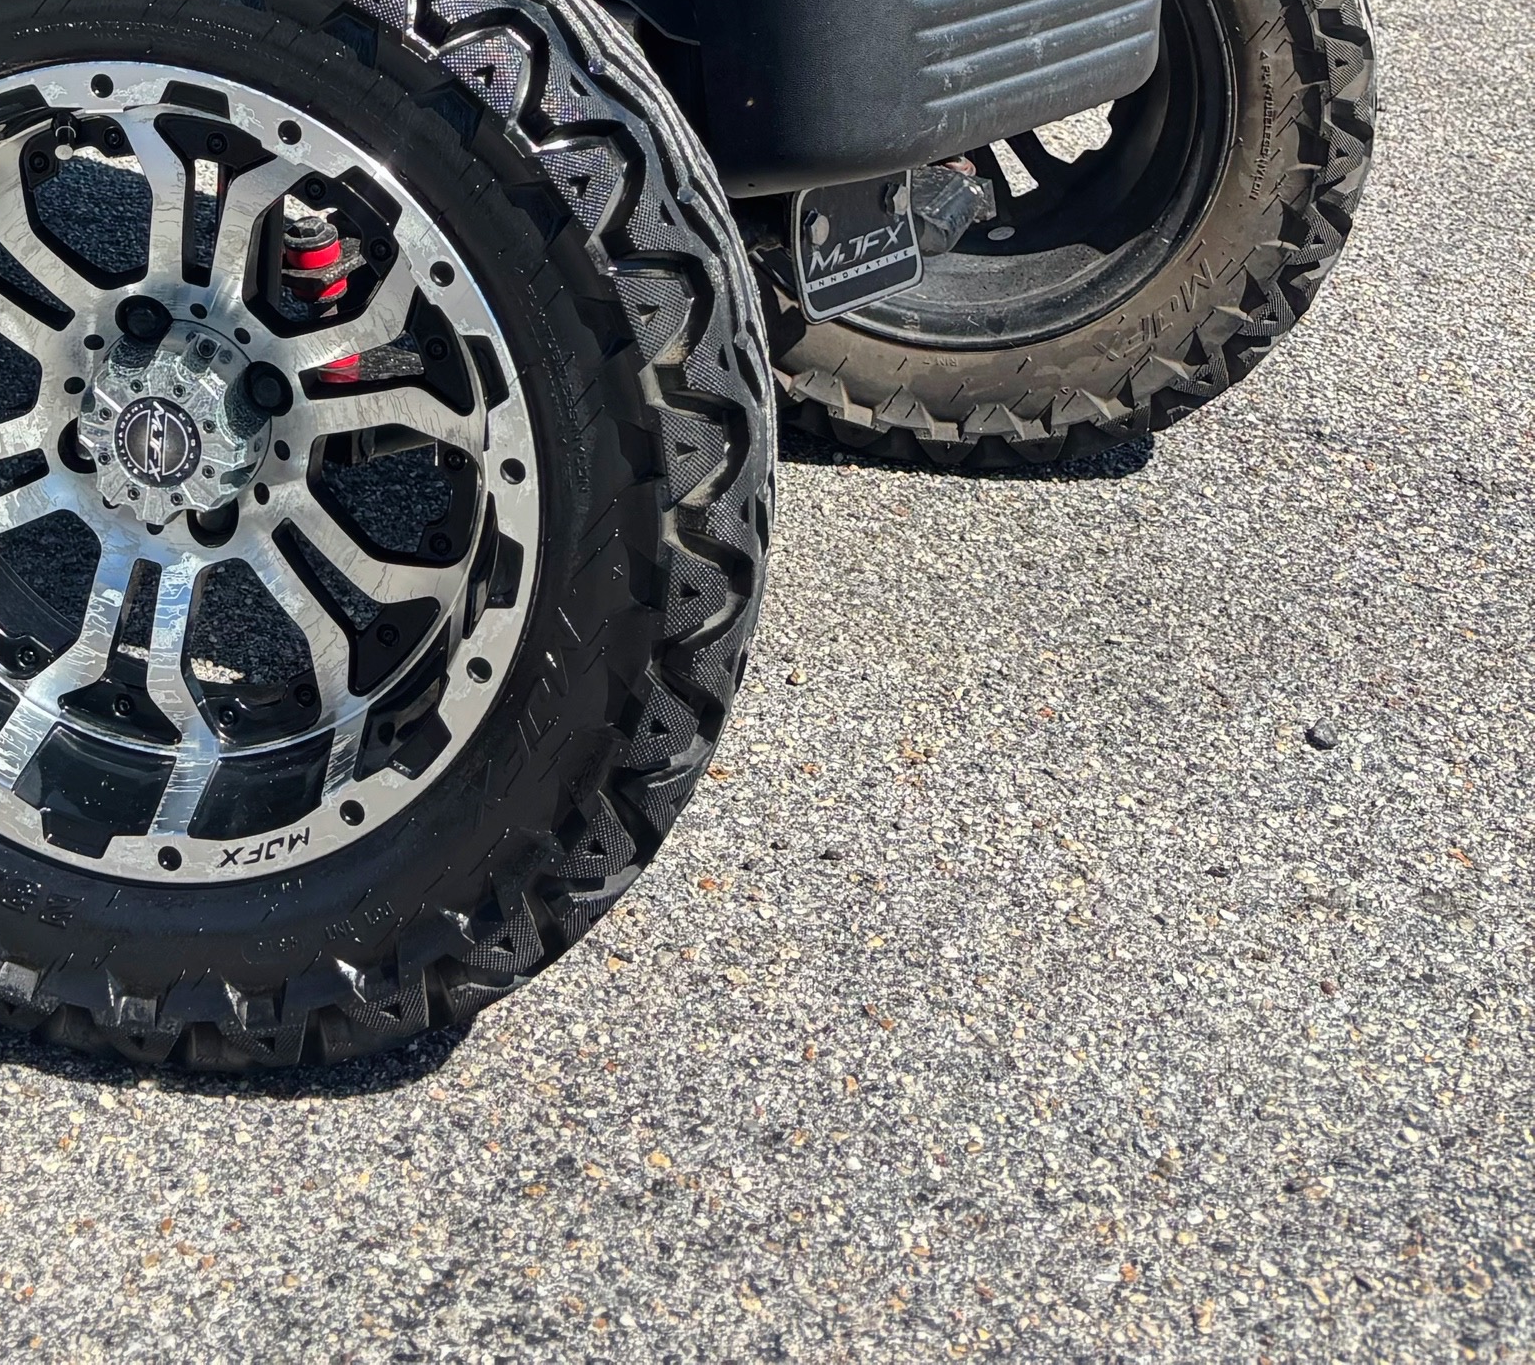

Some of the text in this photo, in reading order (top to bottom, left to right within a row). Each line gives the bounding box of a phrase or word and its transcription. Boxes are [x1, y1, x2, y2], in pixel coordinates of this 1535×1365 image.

[808, 221, 905, 279] MJFX
[809, 250, 908, 290] INNOVATIVE
[216, 826, 310, 869] MJFX
